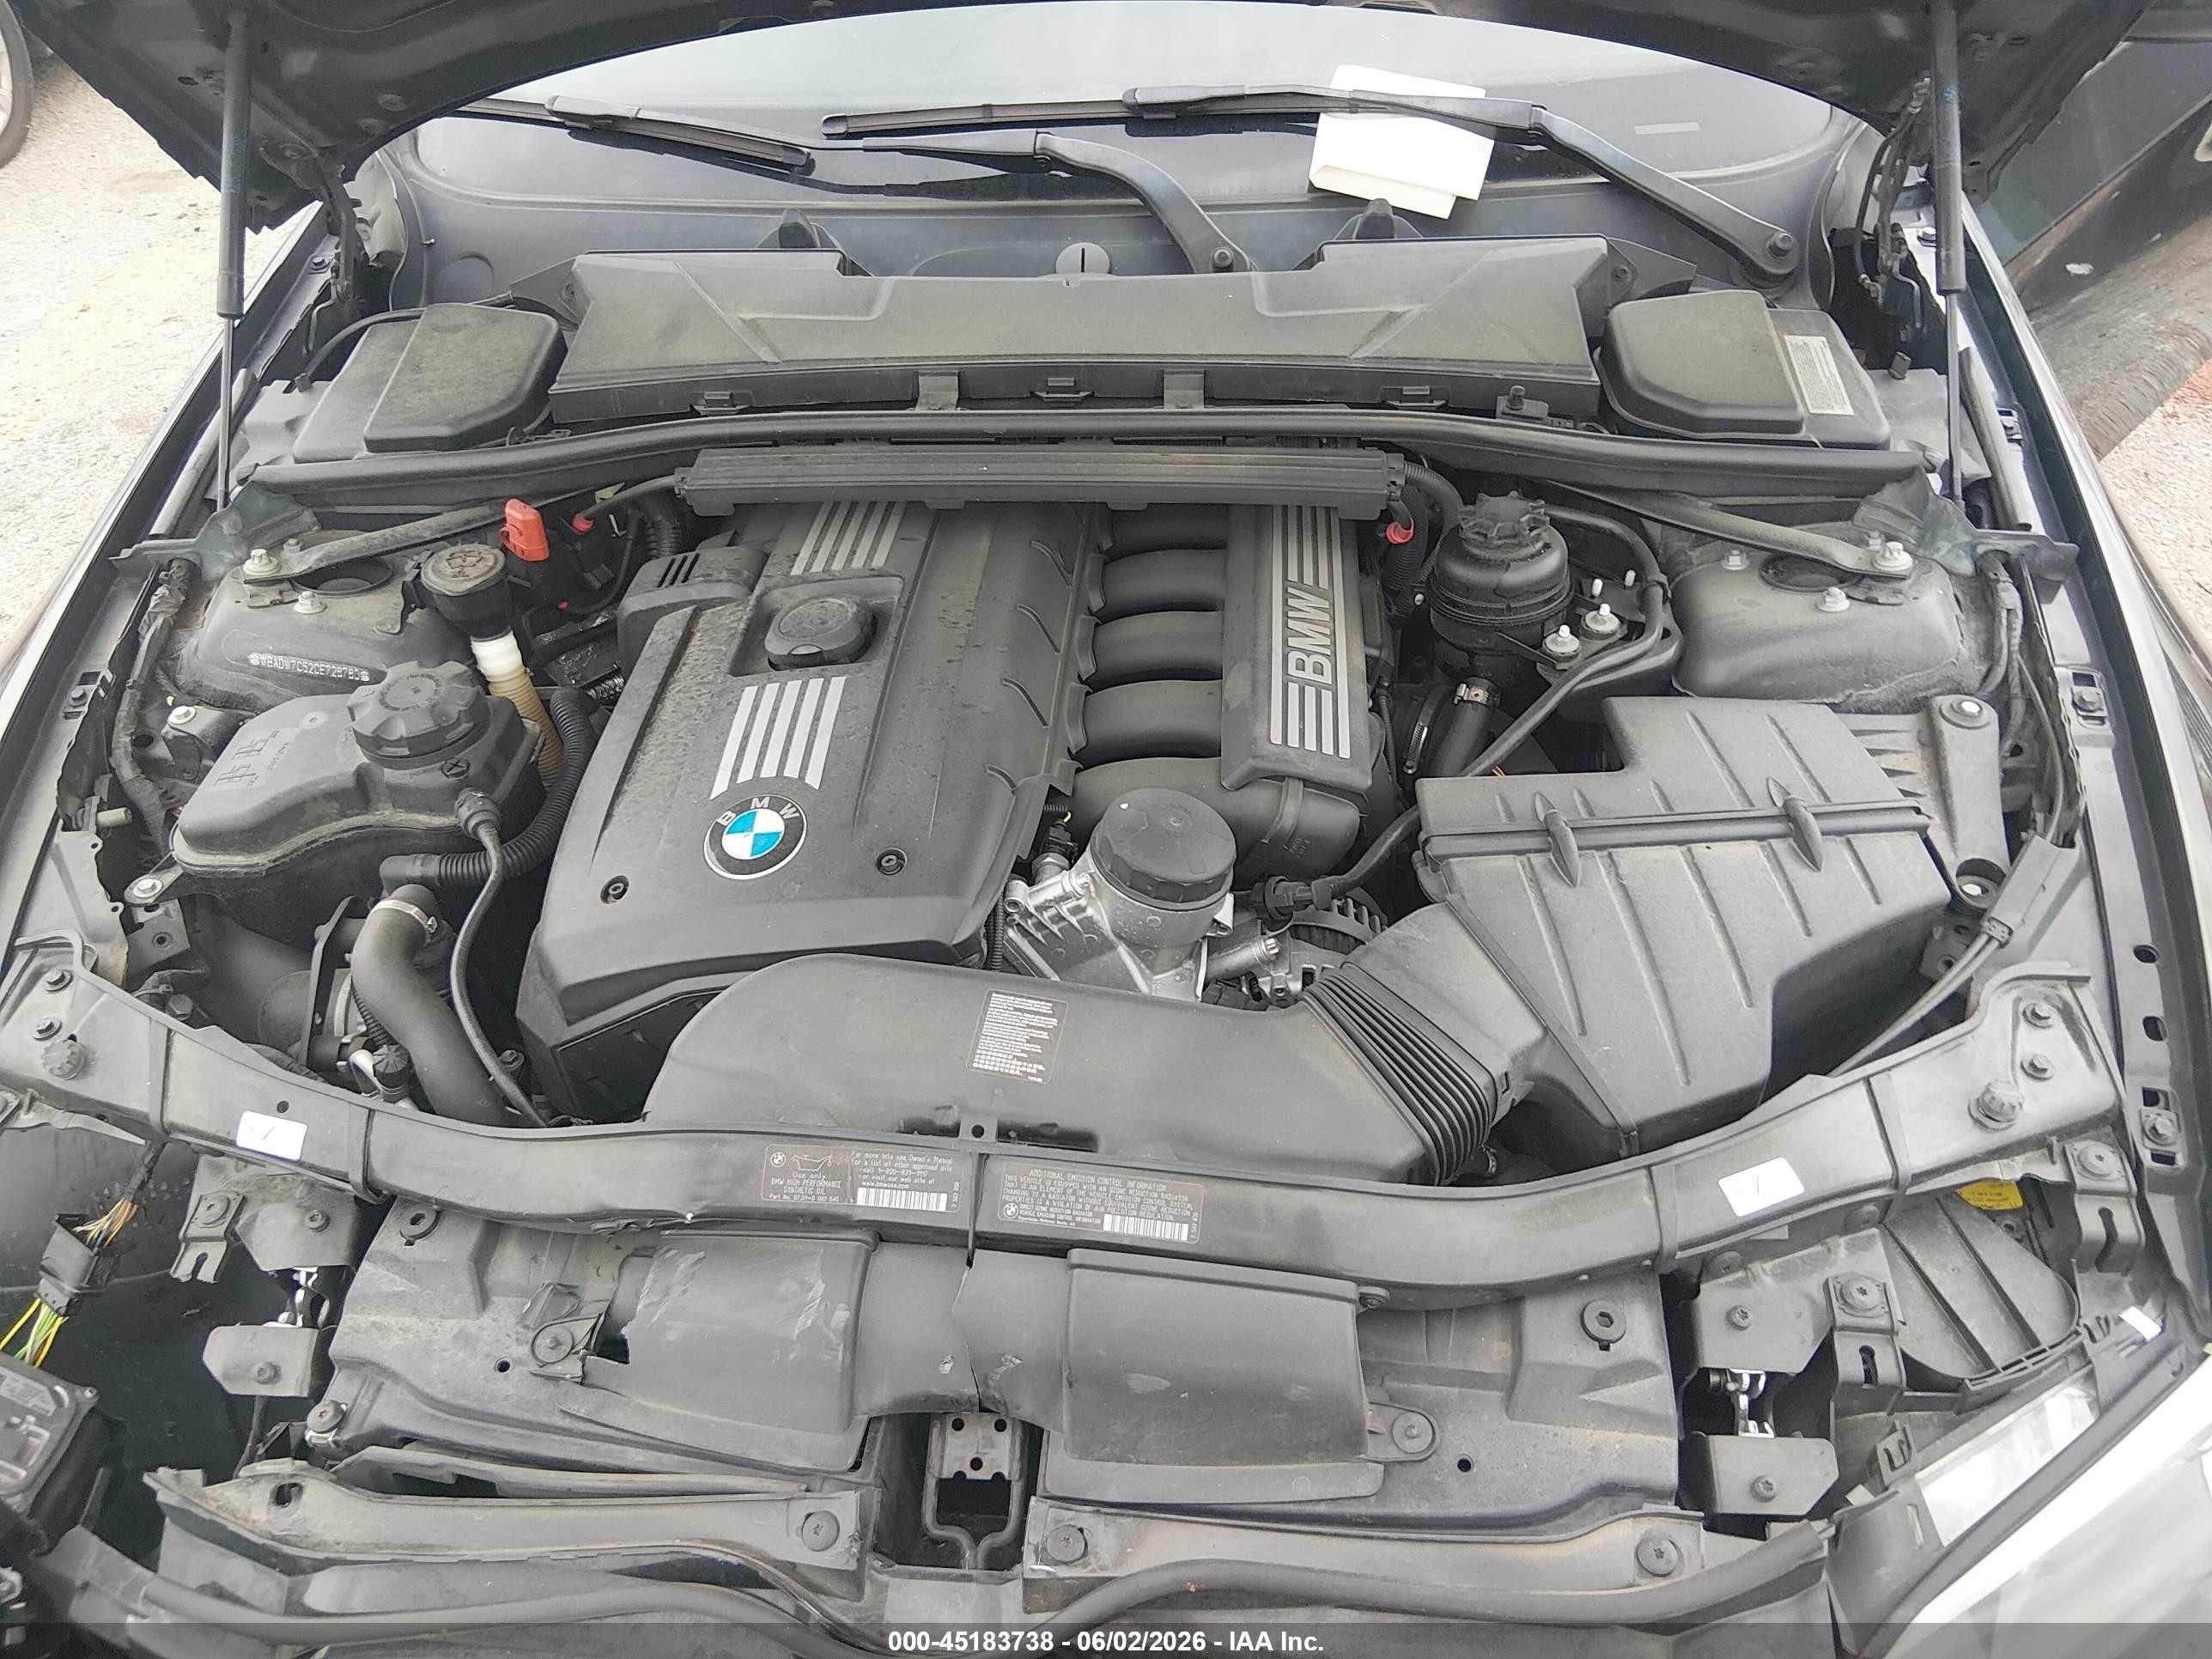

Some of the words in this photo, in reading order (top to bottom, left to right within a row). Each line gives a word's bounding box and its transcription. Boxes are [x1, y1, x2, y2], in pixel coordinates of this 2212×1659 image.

[1287, 586, 1332, 684] BMW
[716, 797, 799, 826] BMW
[882, 1152, 893, 1160] info
[909, 1154, 930, 1163] Owner's
[793, 1170, 805, 1178] Use
[810, 1171, 827, 1181] only
[803, 1179, 842, 1188] PERFORMANCE
[1029, 1169, 1064, 1180] ADDITIONAL
[1066, 1174, 1096, 1182] EMISSION
[1098, 1176, 1123, 1187] CONTROL
[1127, 1181, 1167, 1191] INFORMATION
[1020, 1176, 1042, 1184] VEHICLE
[1054, 1180, 1079, 1188] EQUIPPED
[1129, 1188, 1158, 1197] REDUCTION
[1161, 1193, 1188, 1201] RADIATOR
[1039, 1185, 1063, 1194] ELEMENT
[1090, 1190, 1111, 1200] VEHICLE
[1115, 1194, 1140, 1203] EMISSION
[1142, 1197, 1166, 1206] CONTROL
[1002, 1194, 1034, 1204] PROPERTIES
[1053, 1200, 1083, 1209] VIOLATION
[1107, 1206, 1137, 1216] POLLUTION
[1048, 1193, 1076, 1201] RADIATOR
[1079, 1196, 1102, 1205] WITHOUT
[1104, 1199, 1139, 1209] EQUIVALENT
[1140, 1204, 1158, 1212] OZONE
[1161, 1206, 1191, 1216] REDUCTION
